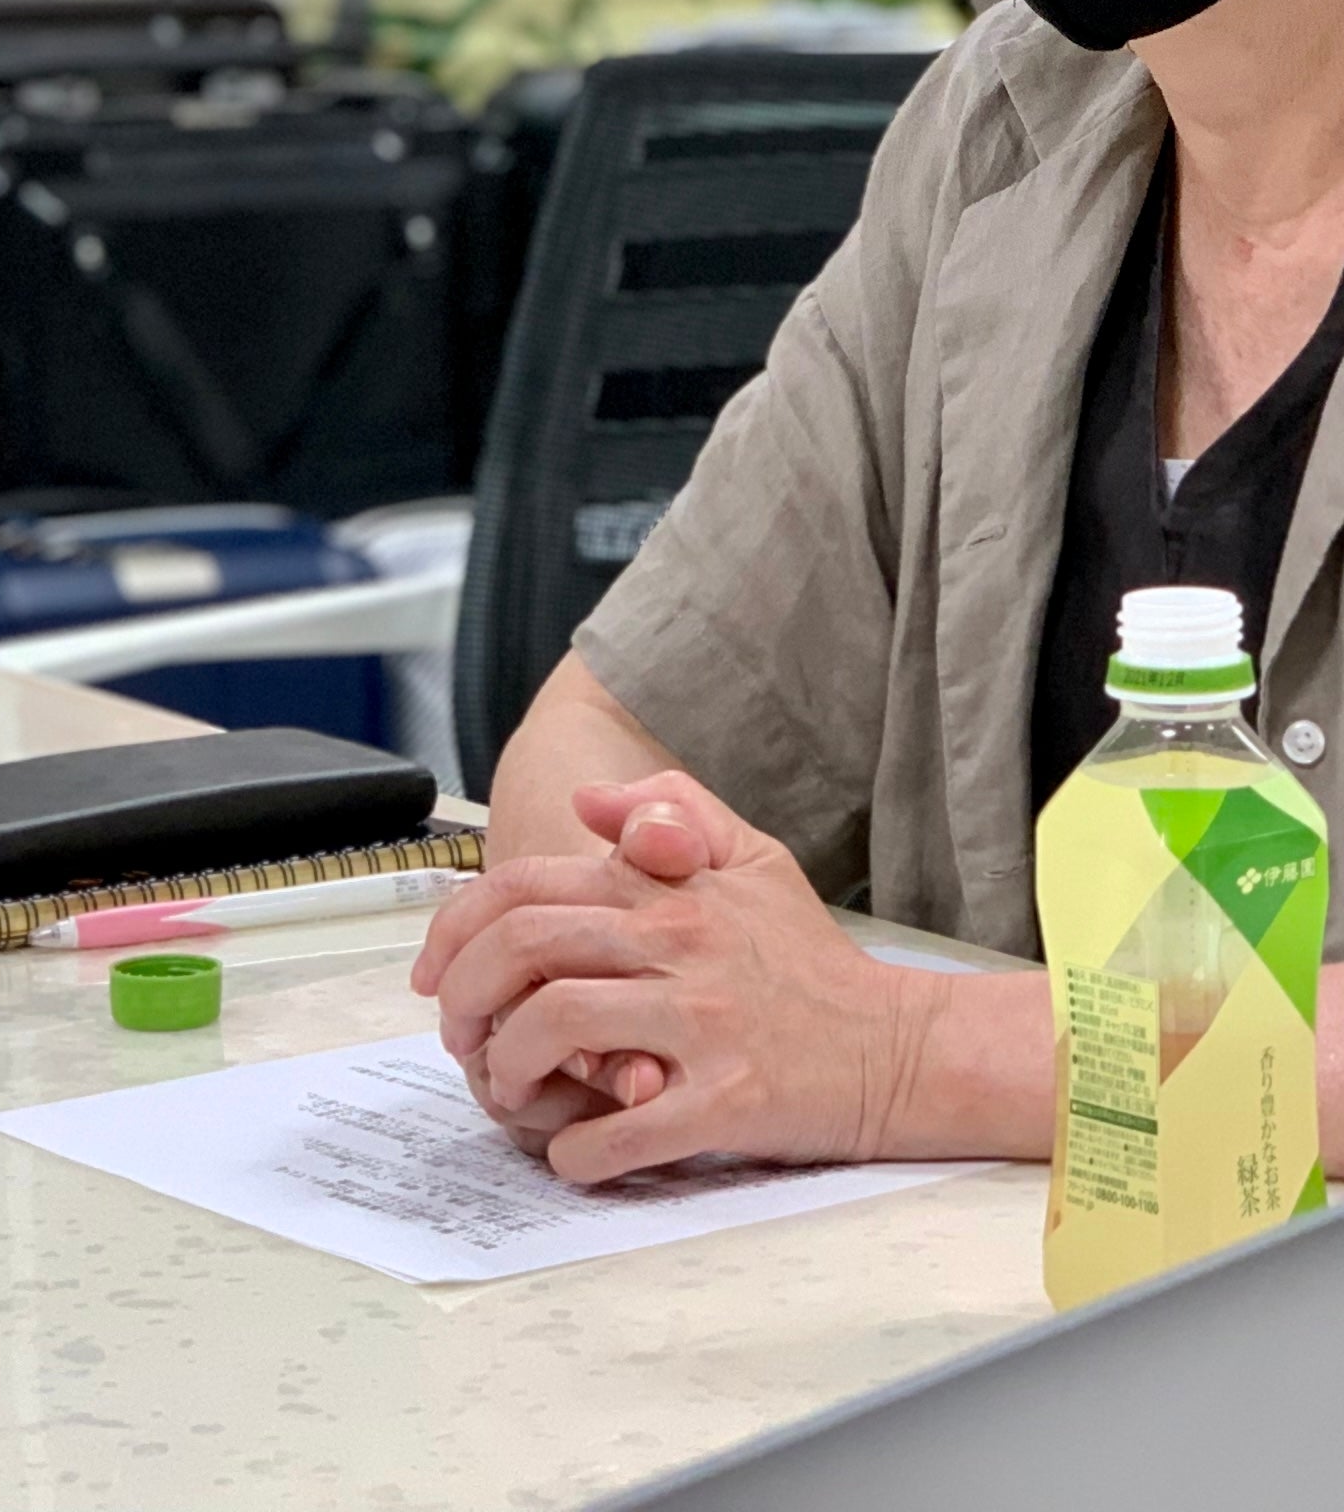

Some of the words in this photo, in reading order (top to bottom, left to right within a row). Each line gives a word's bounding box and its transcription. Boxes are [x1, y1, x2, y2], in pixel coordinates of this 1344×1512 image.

[1263, 856, 1317, 888] 伊藤園
[1260, 1046, 1281, 1211] 香り豊かなお茶
[1237, 1152, 1261, 1218] 緑茶
